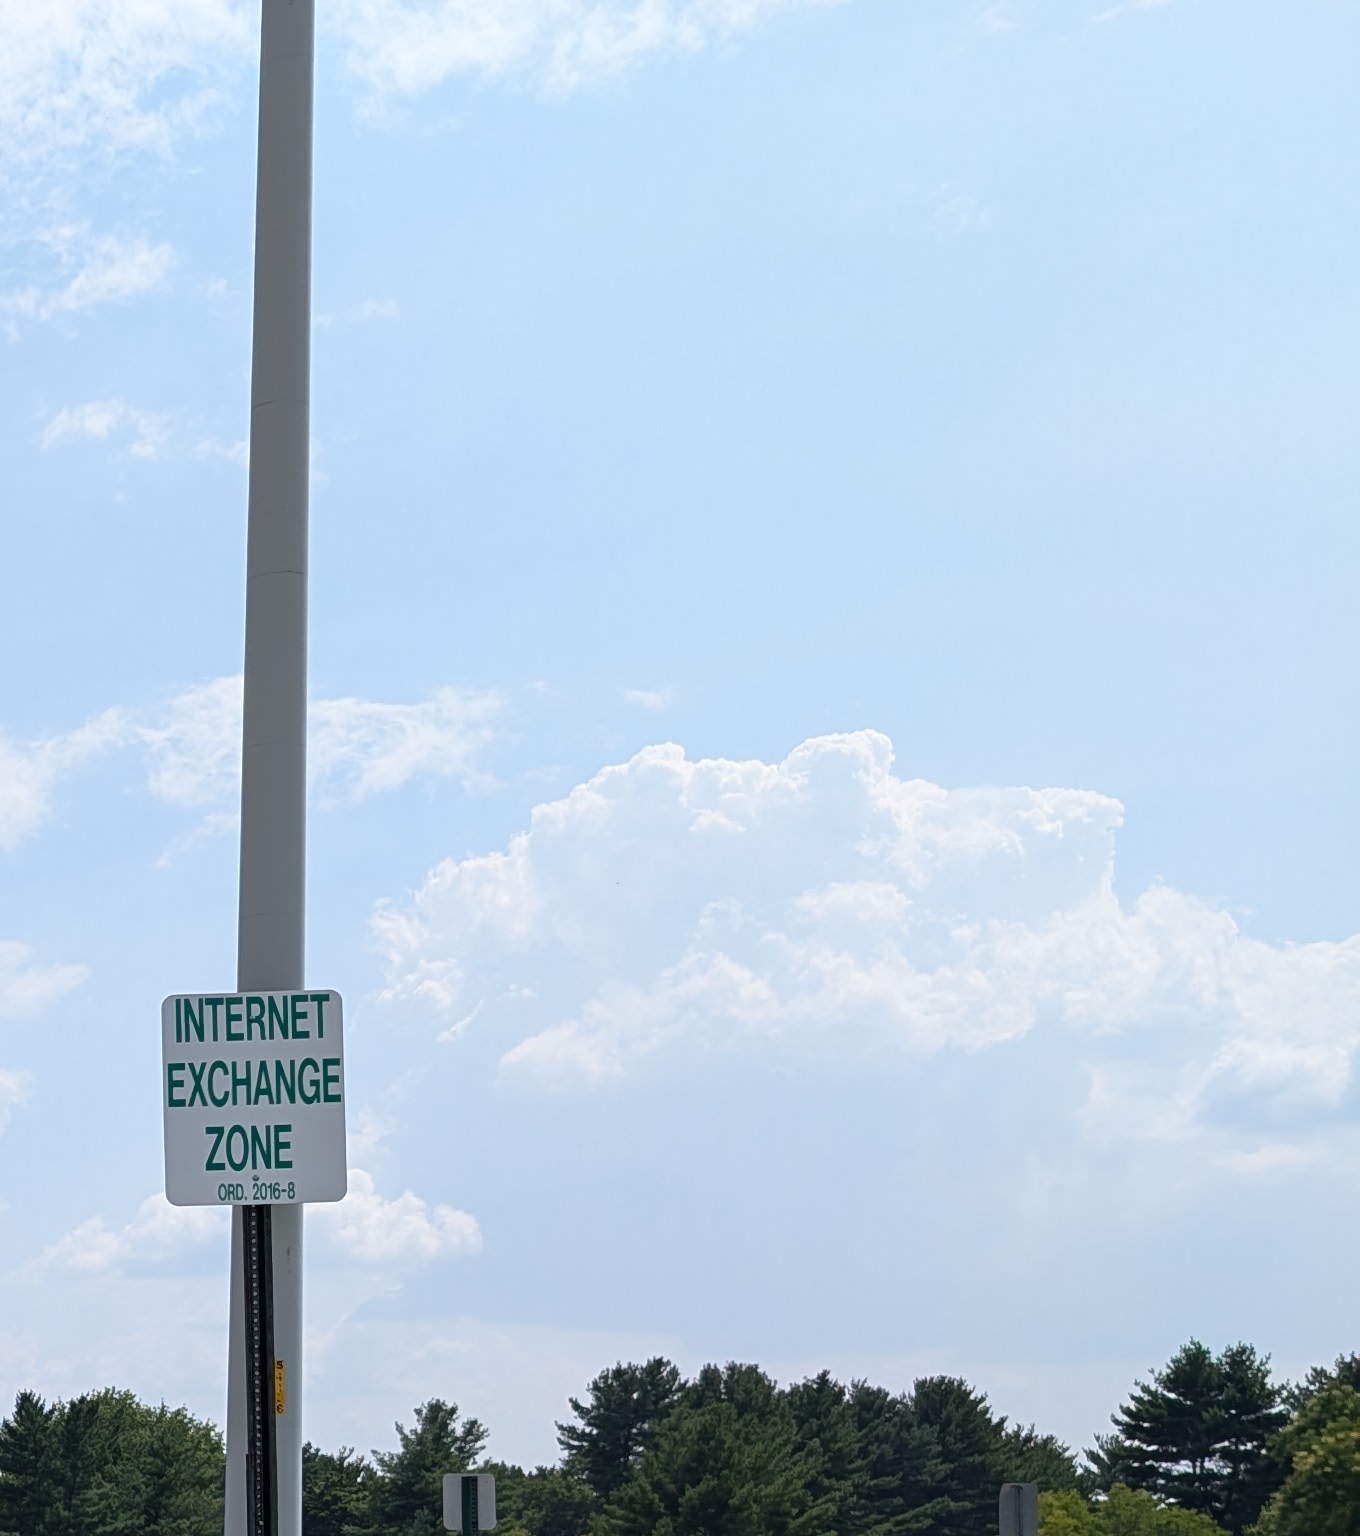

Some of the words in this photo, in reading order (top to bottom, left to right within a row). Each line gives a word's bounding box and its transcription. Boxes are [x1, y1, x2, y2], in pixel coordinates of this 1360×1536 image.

[175, 993, 330, 1043] INTERNET
[167, 1057, 342, 1108] EXCHANGE
[205, 1124, 293, 1172] ZONE
[218, 1183, 248, 1202] ORD.
[252, 1181, 296, 1201] 2016-8
